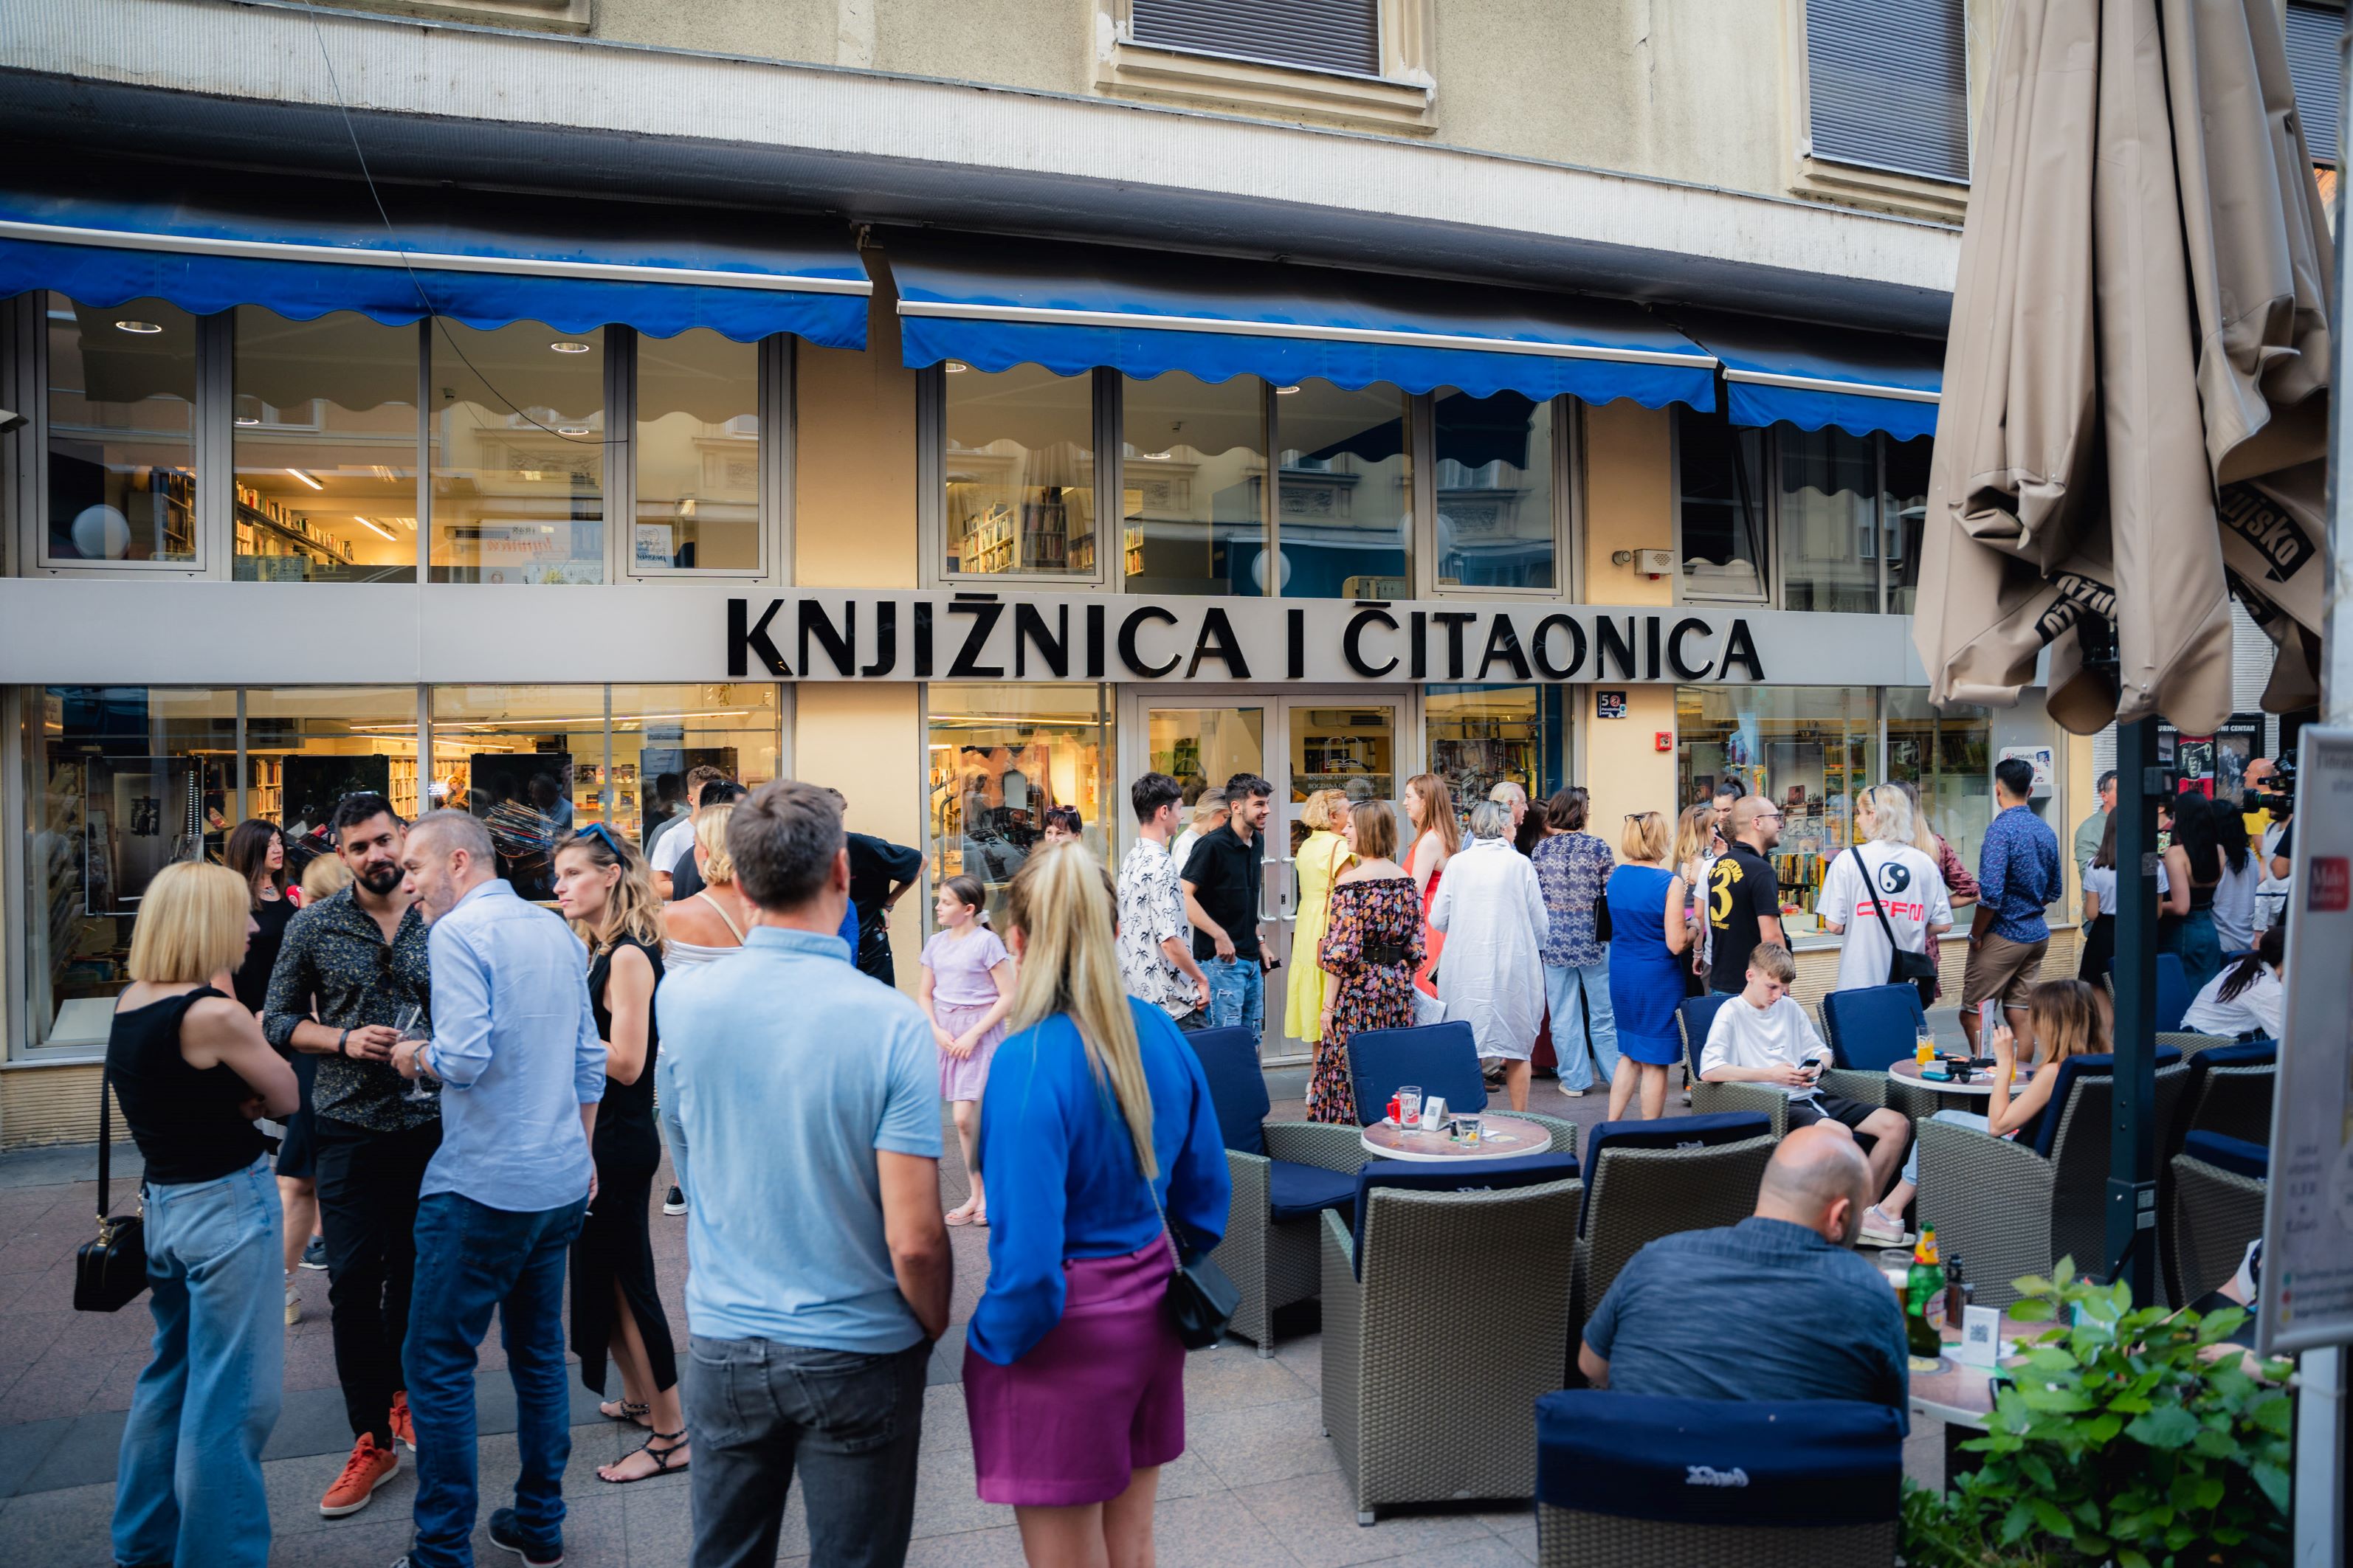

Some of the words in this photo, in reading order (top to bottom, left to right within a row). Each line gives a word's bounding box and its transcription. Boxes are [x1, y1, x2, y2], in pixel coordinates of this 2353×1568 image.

[727, 593, 1252, 679] KNJIŽNICA
[1285, 609, 1305, 679] I
[1343, 601, 1765, 680] ČITAONICA
[1601, 694, 1609, 706] 5
[1709, 866, 1733, 922] 3
[1856, 899, 1924, 922] CPFM
